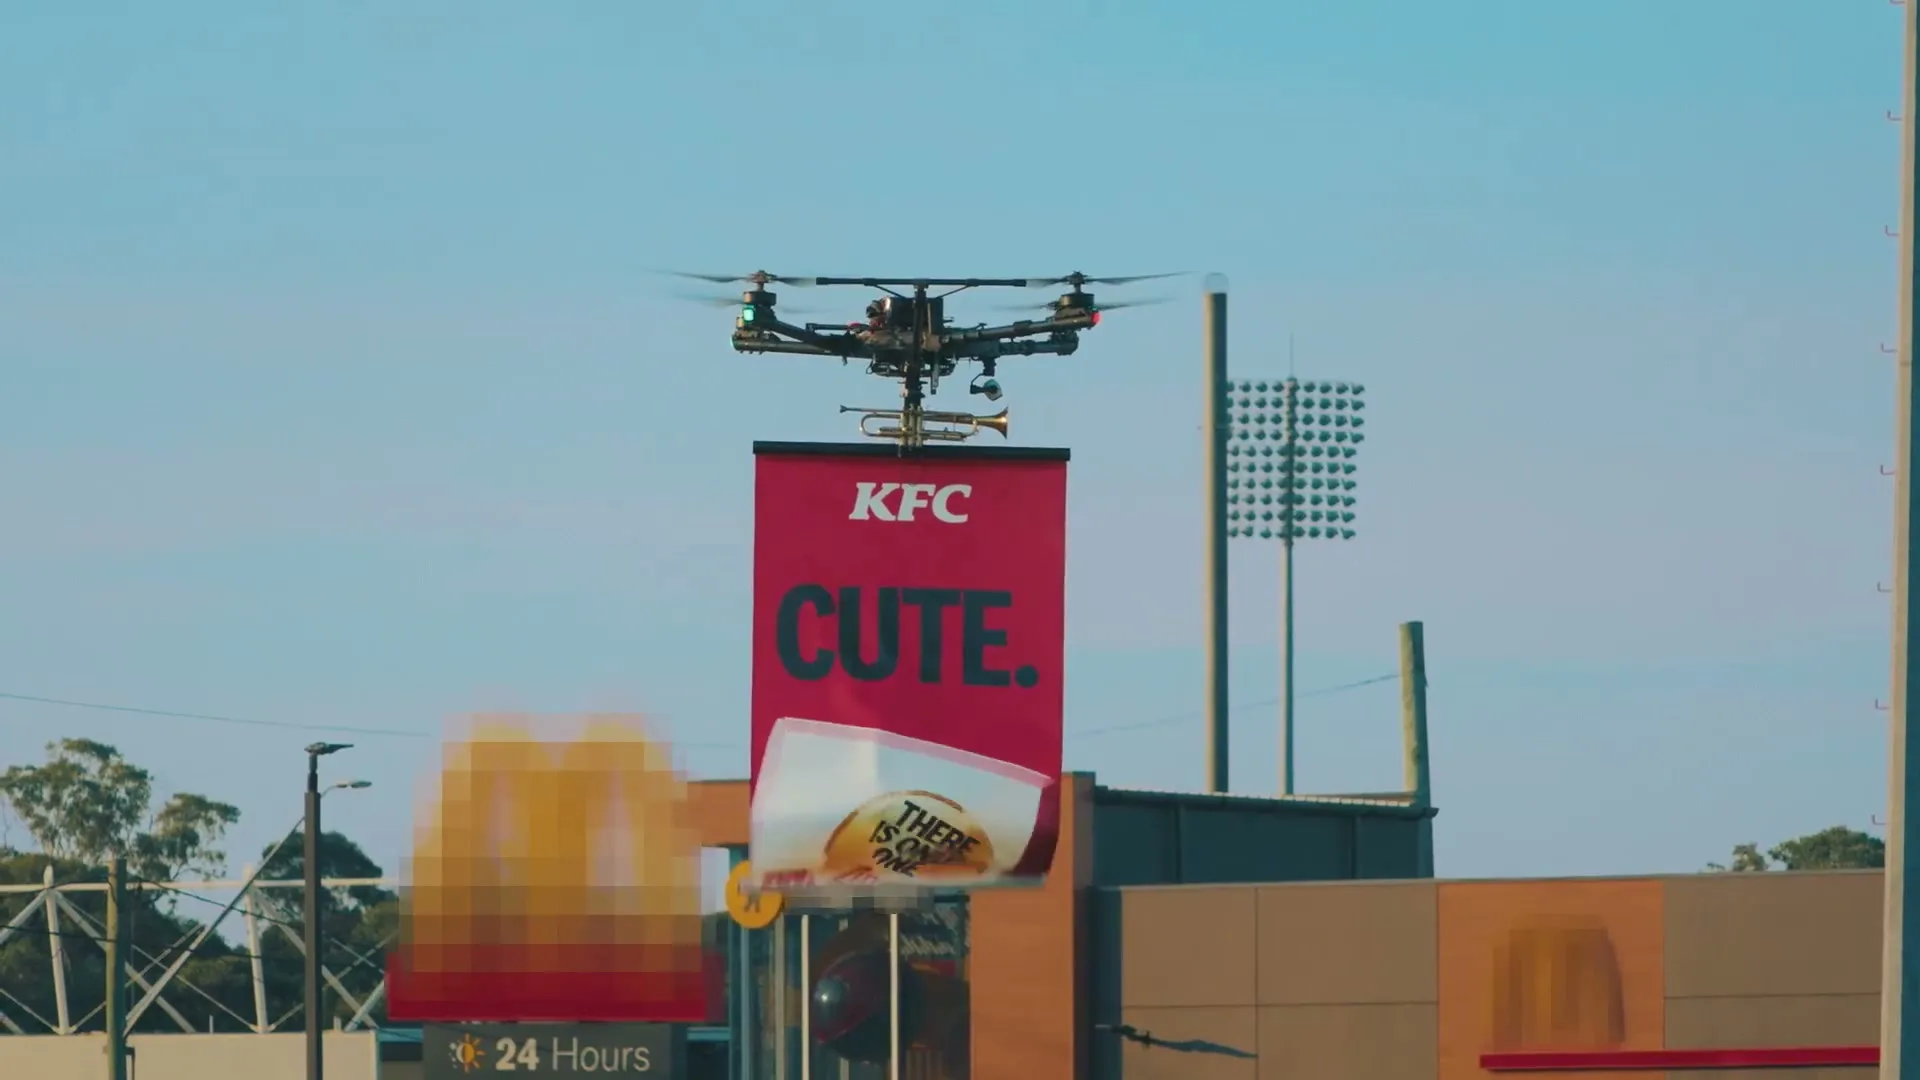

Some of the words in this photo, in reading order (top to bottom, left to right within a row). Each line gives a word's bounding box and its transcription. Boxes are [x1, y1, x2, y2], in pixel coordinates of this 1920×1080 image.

[849, 482, 973, 523] KFC
[776, 583, 1040, 688] CUTE.
[869, 820, 900, 843] IS
[495, 1037, 540, 1071] 24
[552, 1037, 651, 1072] Hours
